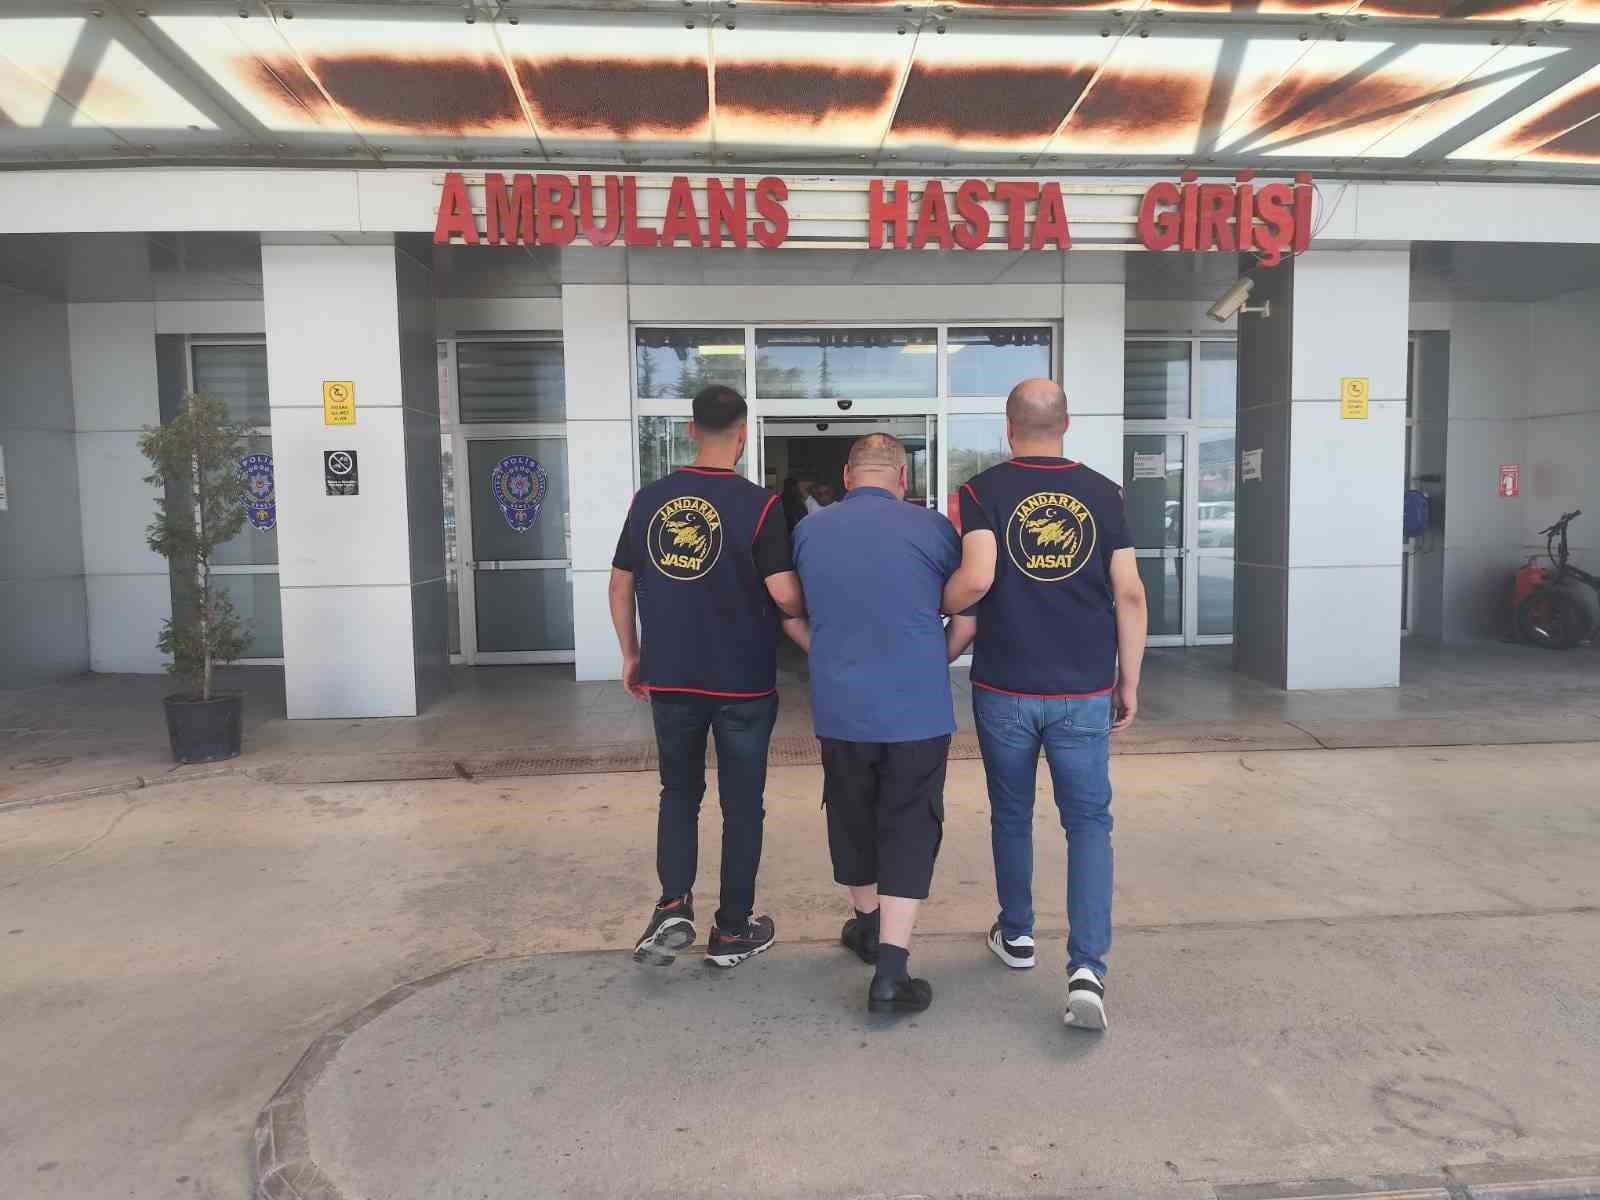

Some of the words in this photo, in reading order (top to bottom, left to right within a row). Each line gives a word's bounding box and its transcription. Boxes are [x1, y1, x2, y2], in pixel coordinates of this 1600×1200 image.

[432, 171, 790, 248] AMBULANS
[867, 179, 1073, 251] HASTA
[1136, 170, 1313, 267] GİRİŞİ
[660, 499, 721, 532] JANDARMA
[1016, 495, 1089, 523] JANDARMA
[660, 551, 704, 571] JASAT
[1026, 554, 1074, 569] JASAT
